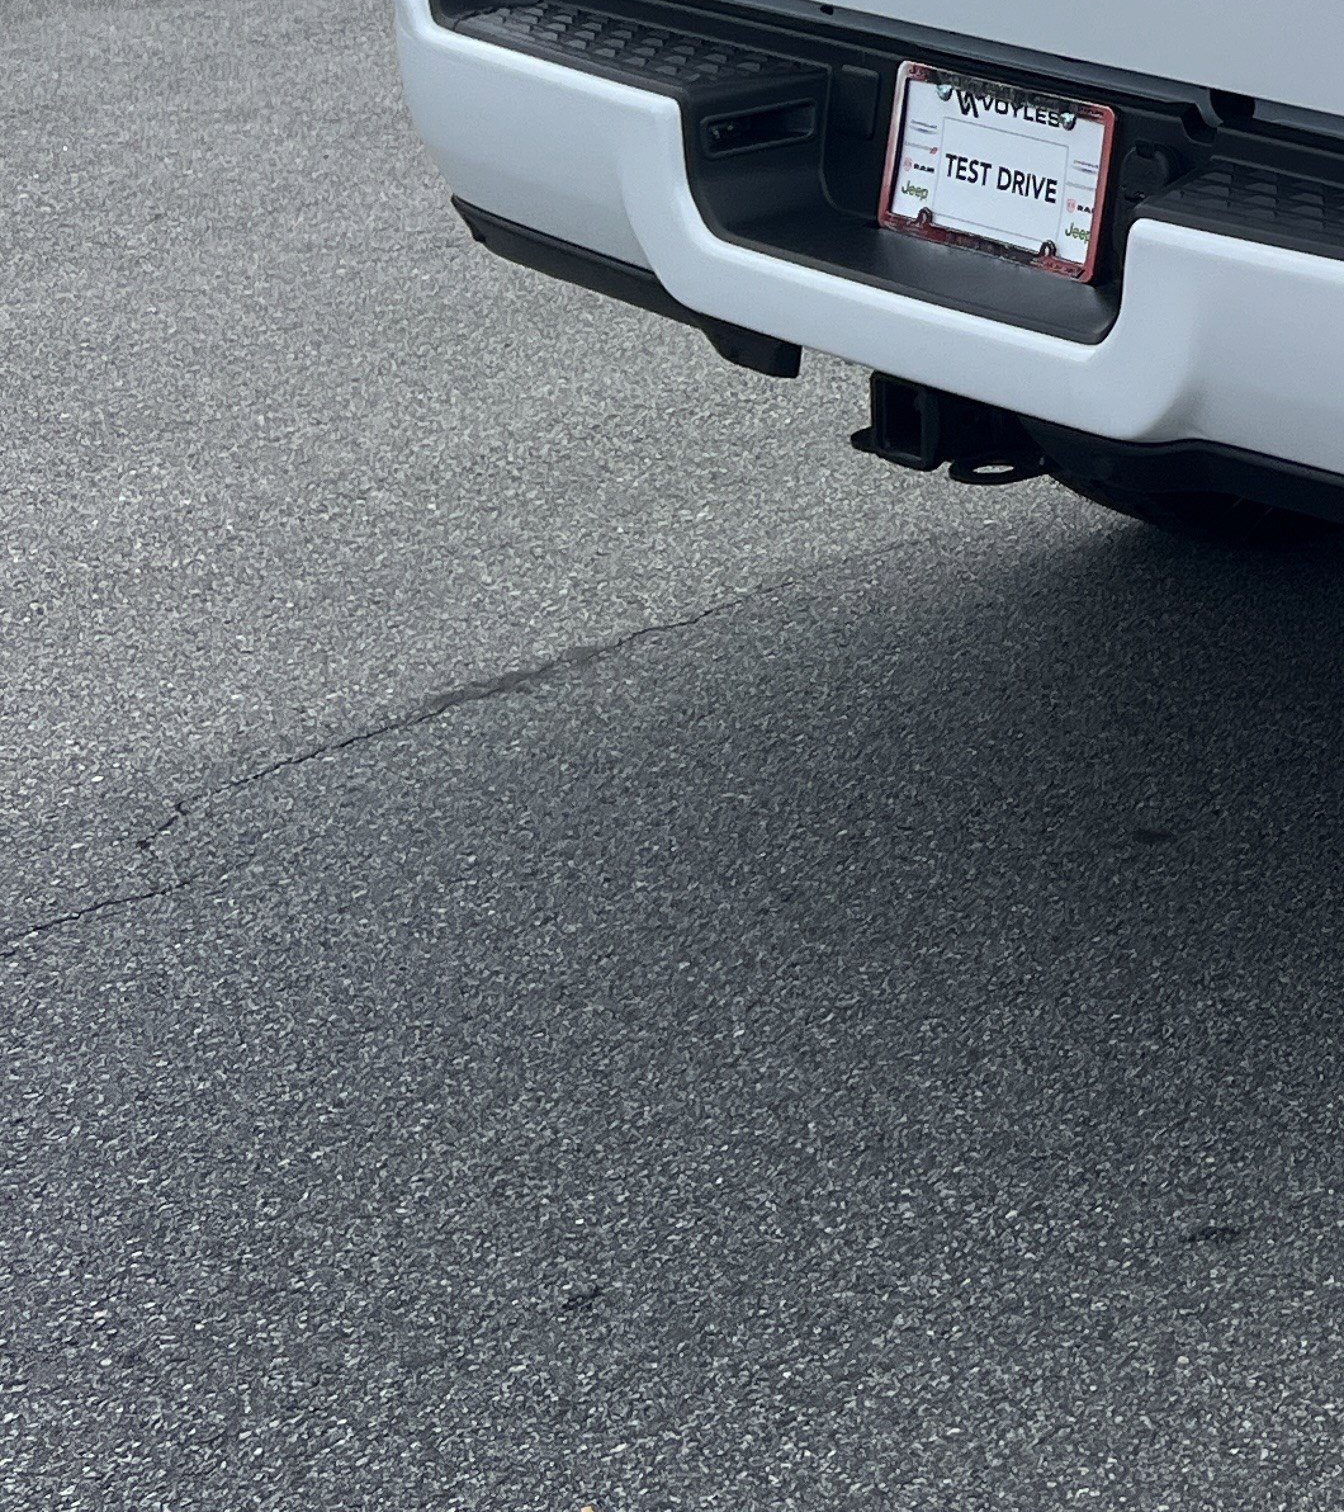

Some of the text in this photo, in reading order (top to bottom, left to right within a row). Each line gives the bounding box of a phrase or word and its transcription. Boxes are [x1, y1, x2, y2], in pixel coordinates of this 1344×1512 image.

[982, 96, 1060, 128] VOYLES
[901, 180, 929, 200] Jeep
[945, 153, 992, 186] TEST
[997, 165, 1058, 204] DRIVE
